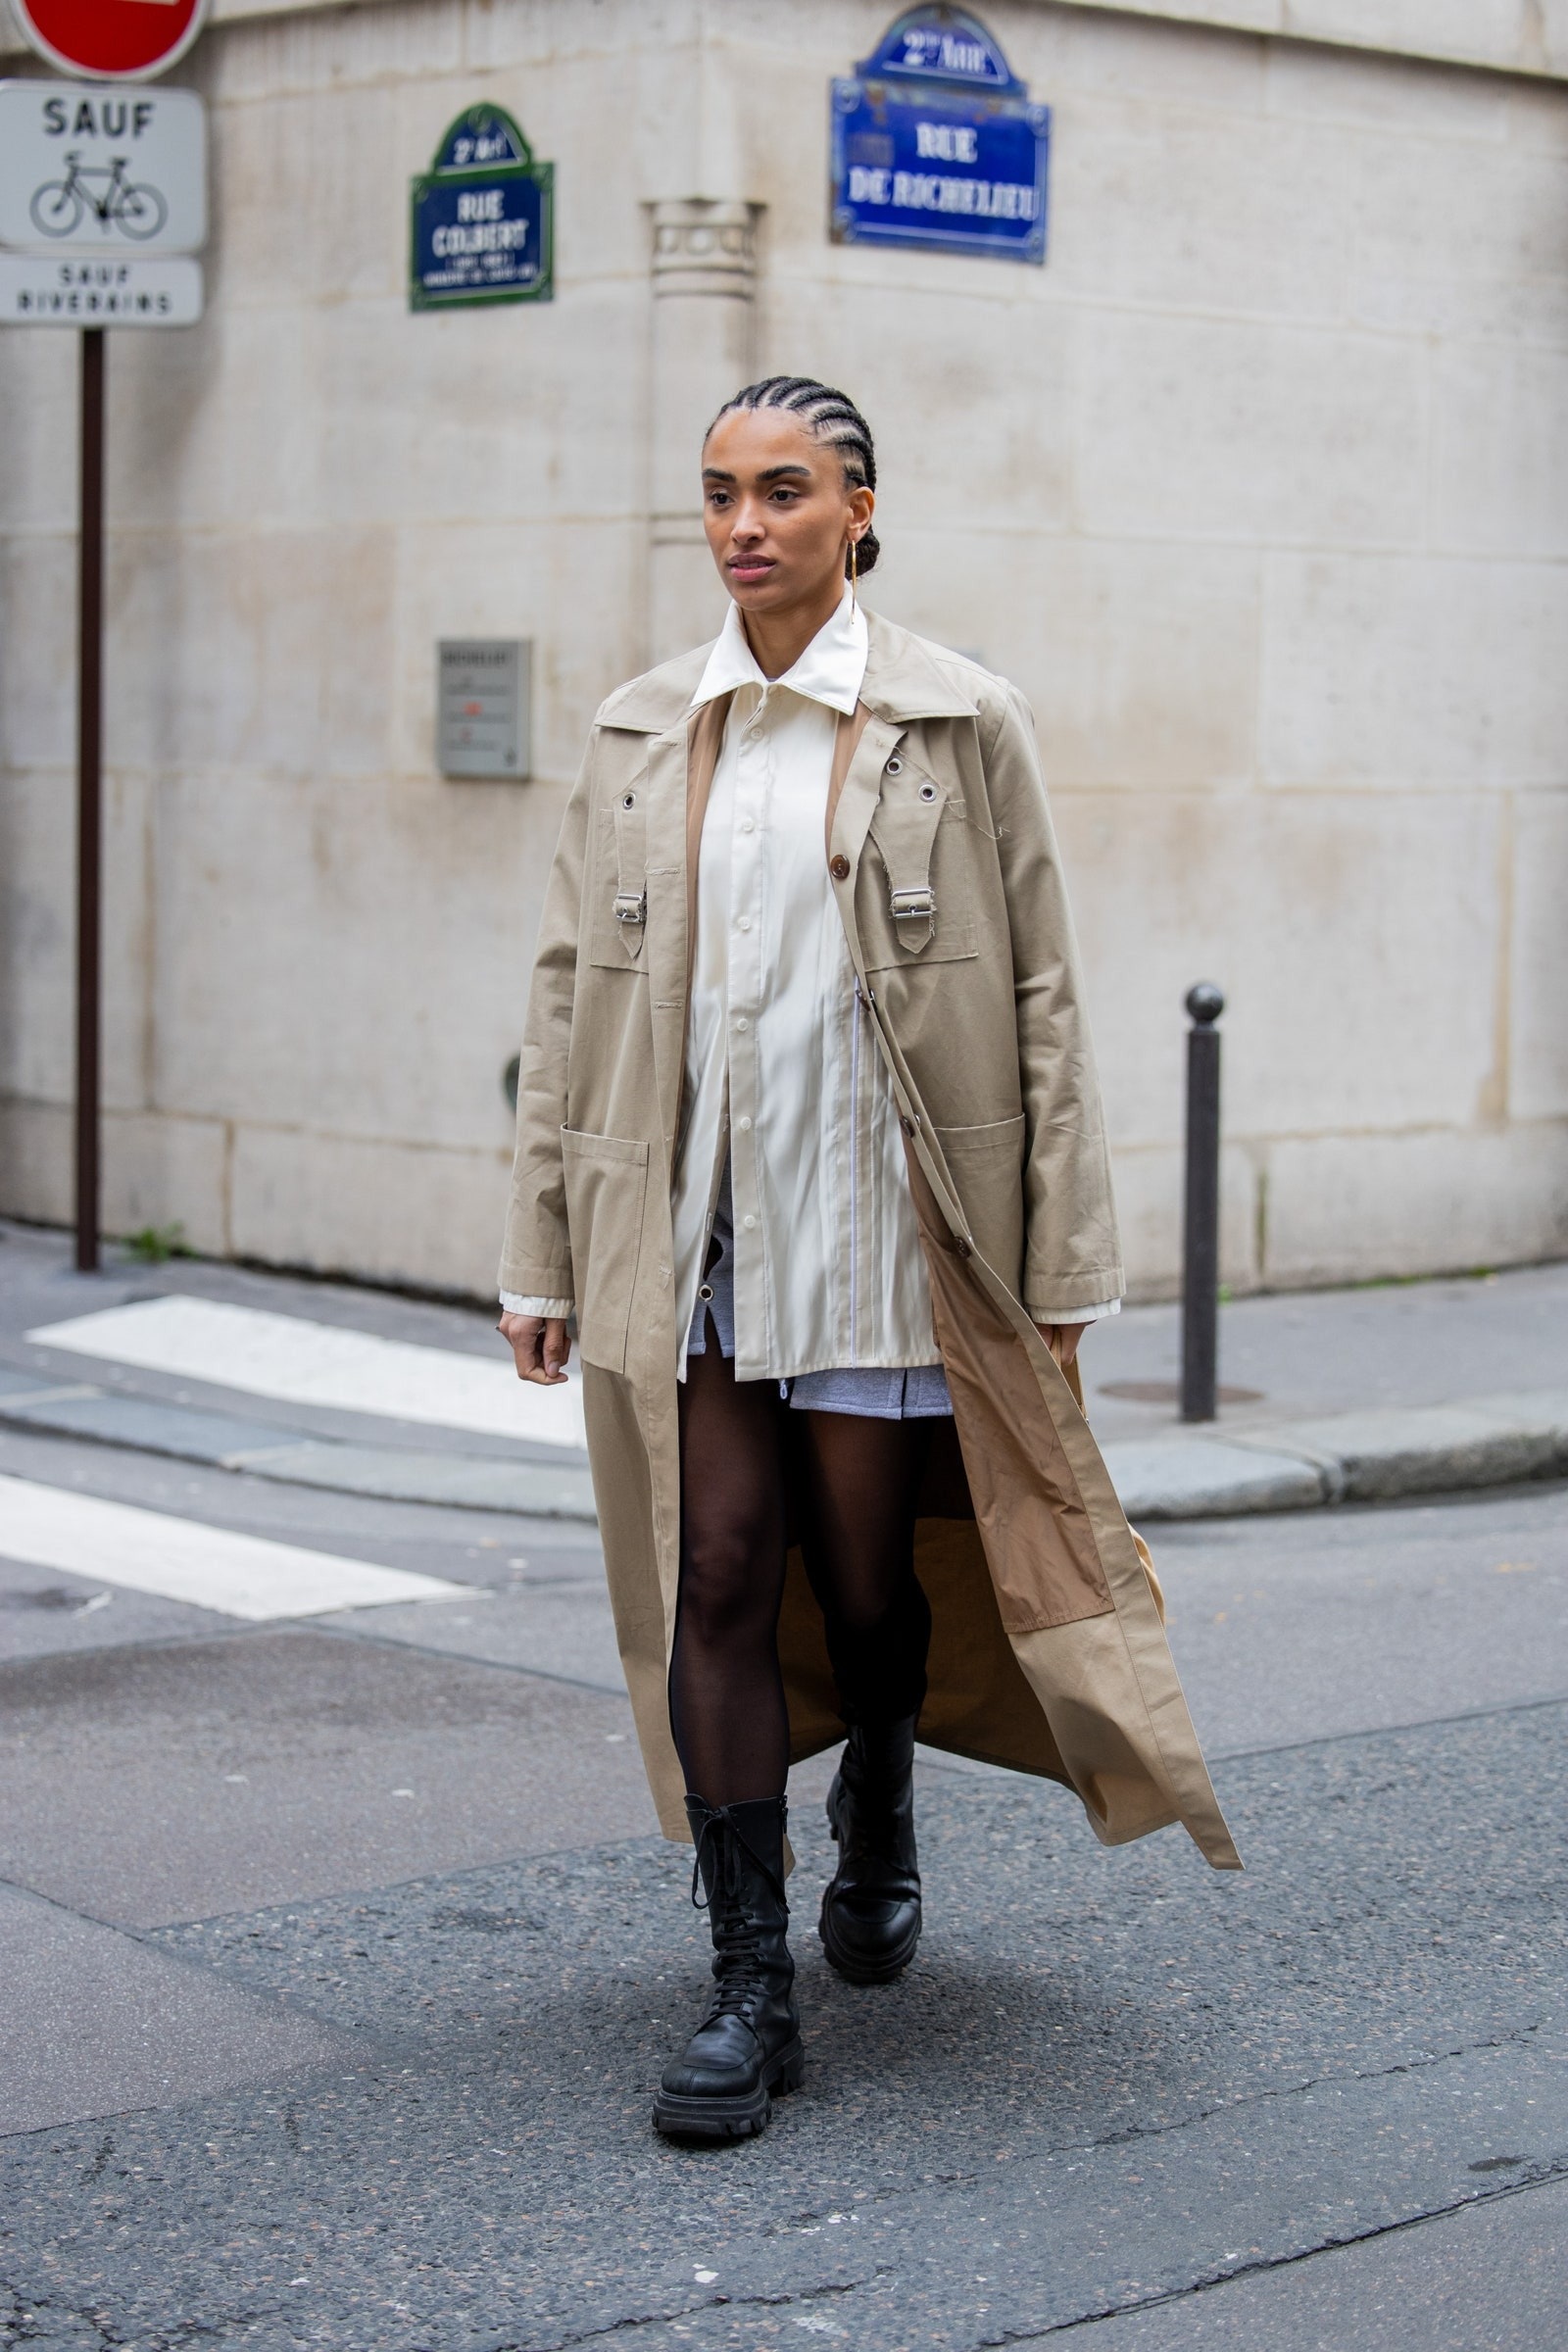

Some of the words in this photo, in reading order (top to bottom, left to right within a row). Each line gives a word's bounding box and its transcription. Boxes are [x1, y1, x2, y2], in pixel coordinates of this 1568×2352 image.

[43, 99, 154, 138] SAUF
[916, 122, 978, 163] RUE
[458, 190, 505, 222] RUE
[849, 167, 891, 204] DE
[893, 172, 1037, 220] RICHELIEU
[432, 219, 529, 257] COLBERT
[60, 265, 131, 285] SAUF
[18, 292, 171, 314] RIVERAINS
